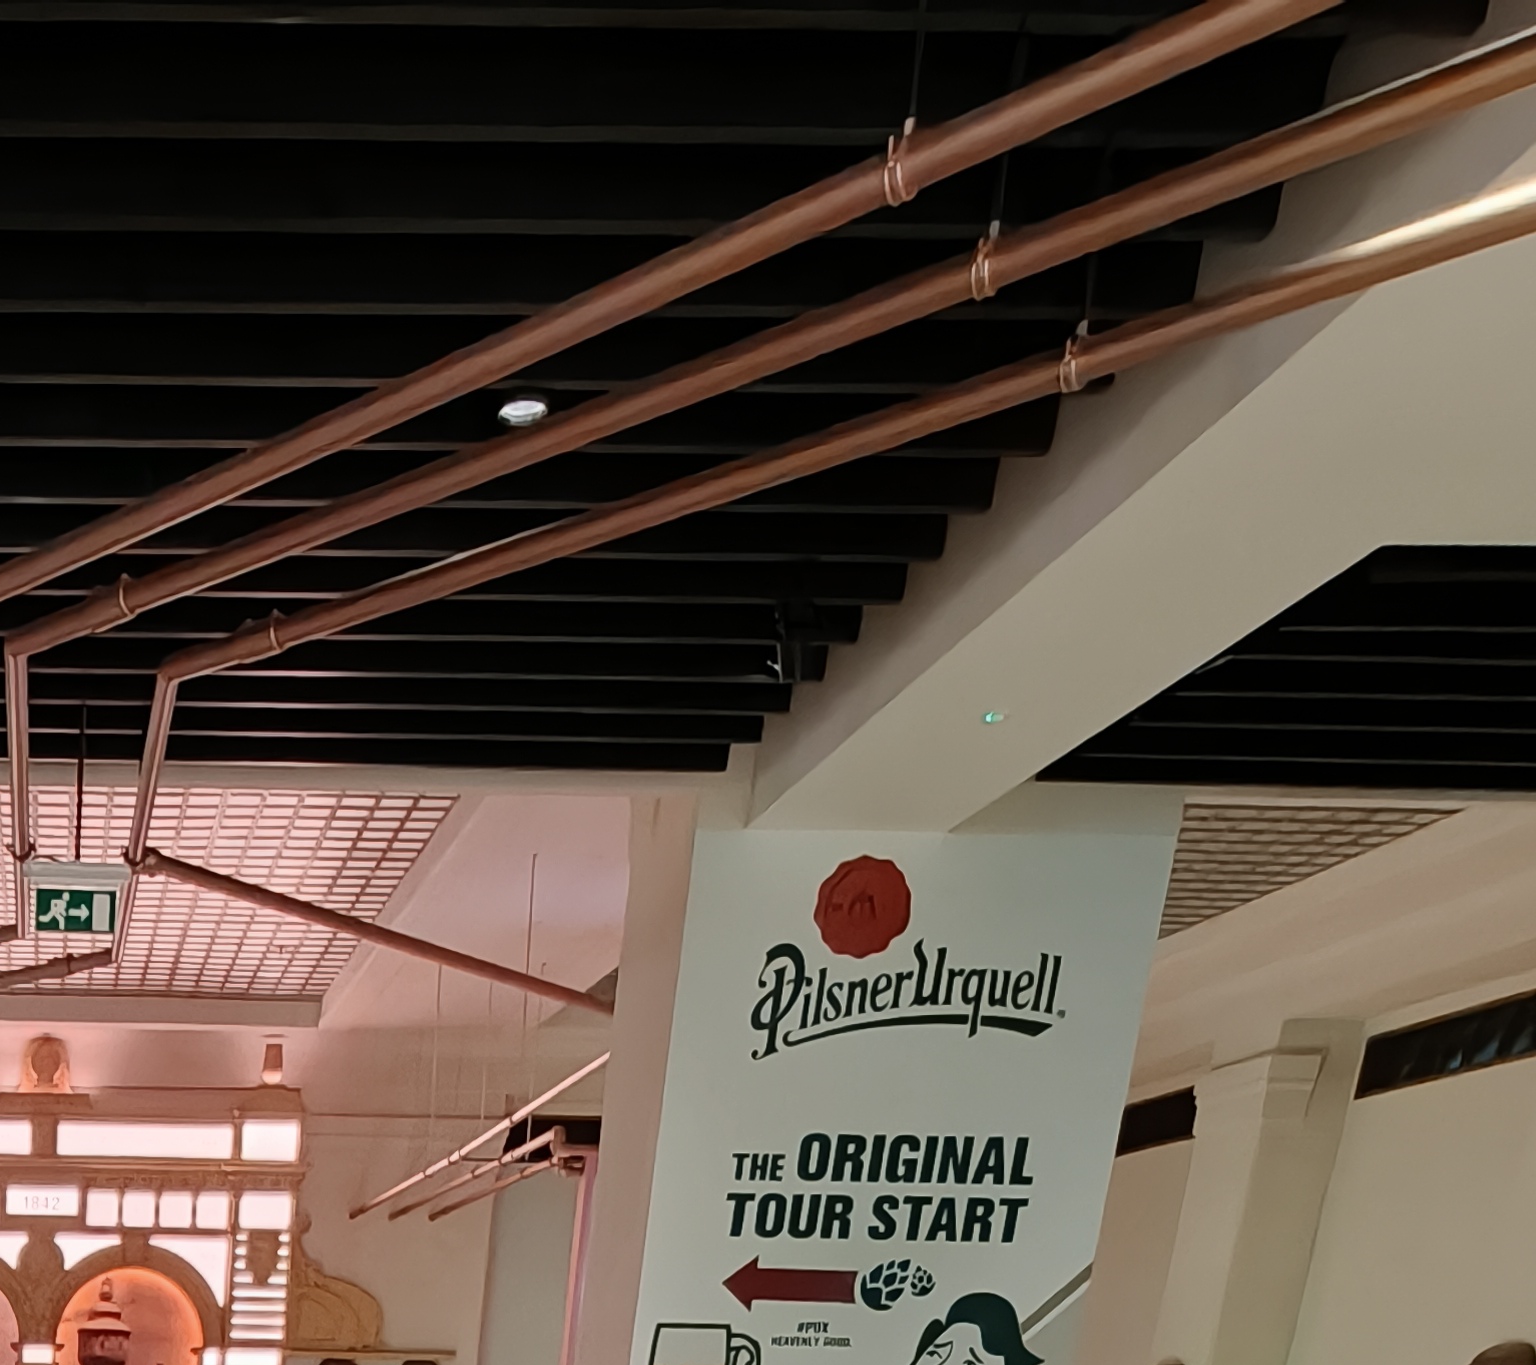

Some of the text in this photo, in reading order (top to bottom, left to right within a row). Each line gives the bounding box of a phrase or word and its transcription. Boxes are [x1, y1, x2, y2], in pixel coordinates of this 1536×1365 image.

[749, 938, 1063, 1061] Pilsner Urquell
[731, 1132, 1034, 1186] THE ORIGINAL
[24, 1196, 60, 1210] 1842
[725, 1191, 1029, 1244] TOUR START
